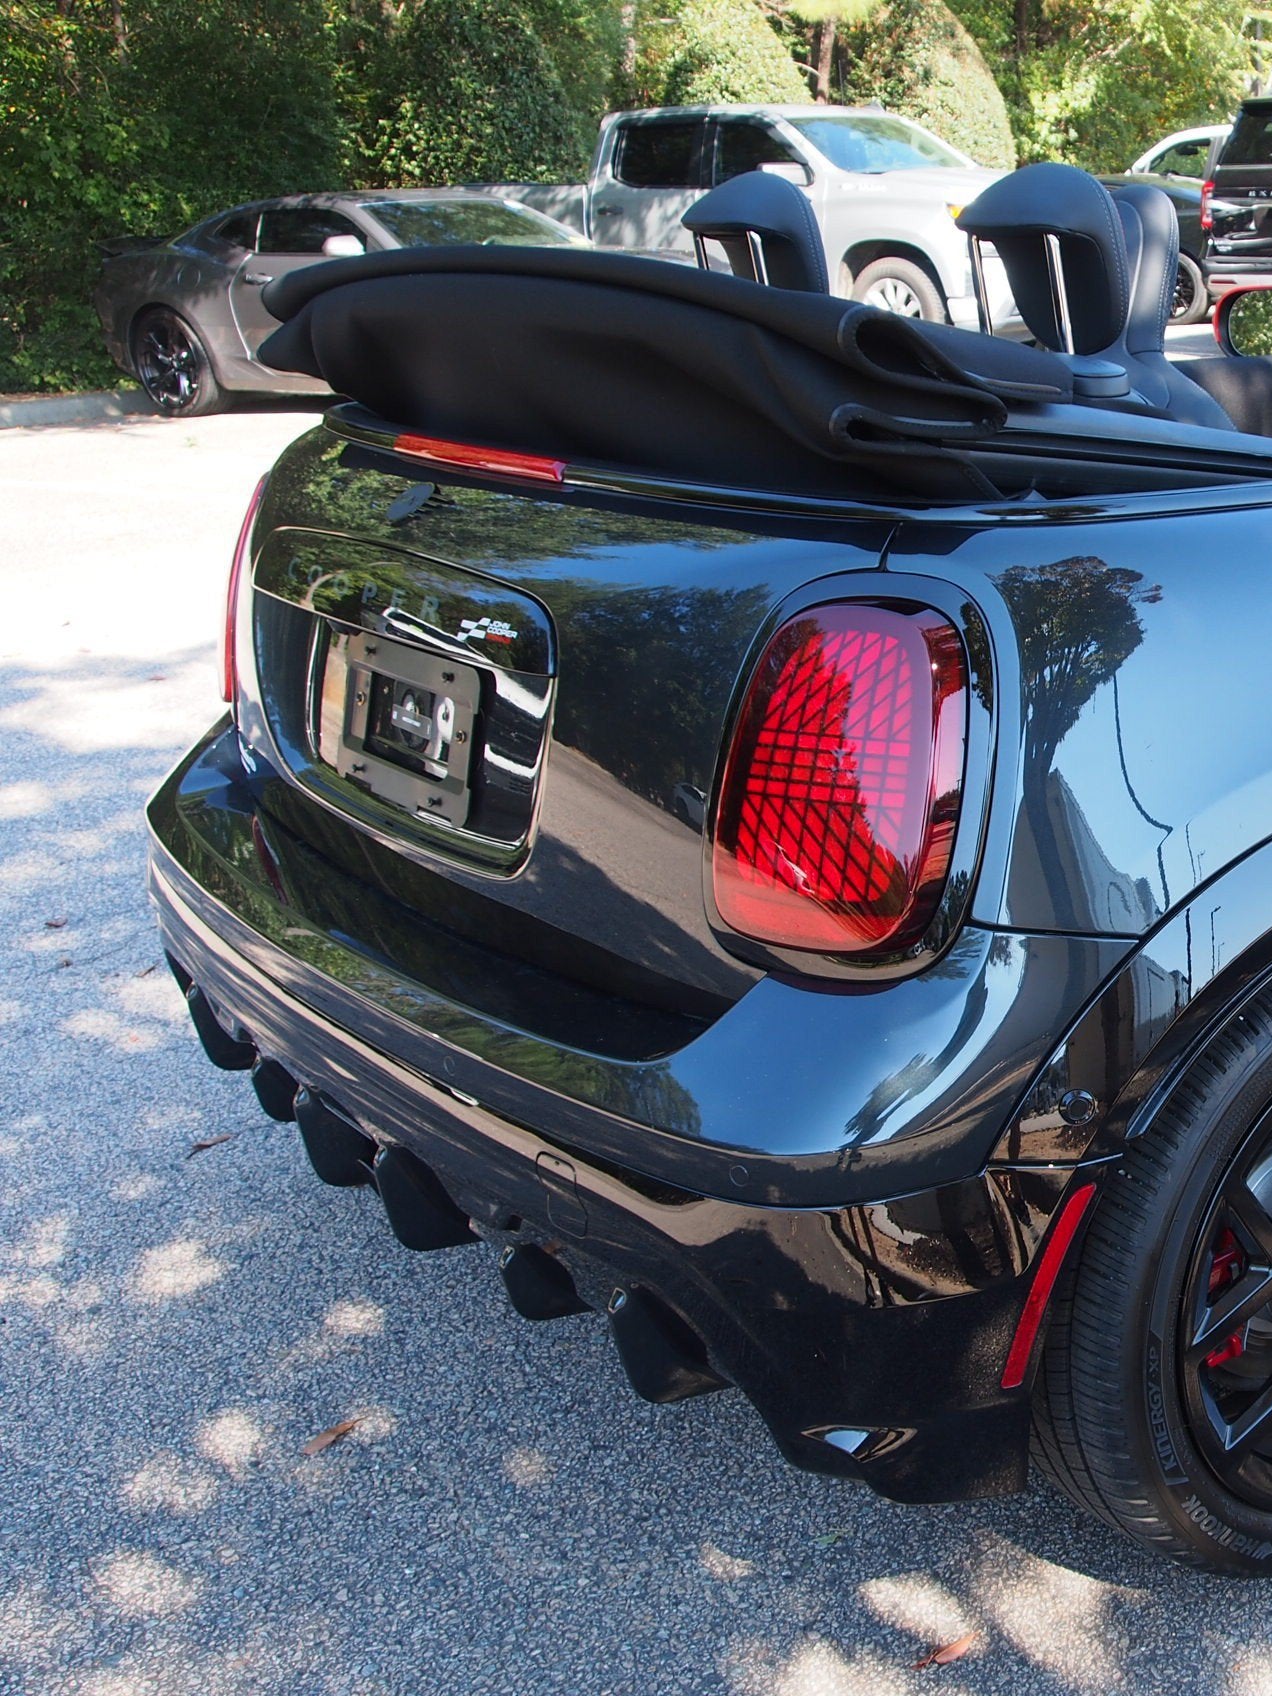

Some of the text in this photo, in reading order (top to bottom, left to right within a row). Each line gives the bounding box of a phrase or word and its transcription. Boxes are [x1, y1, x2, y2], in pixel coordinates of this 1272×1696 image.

[288, 557, 440, 623] COOPER
[486, 626, 518, 640] COOPER
[1148, 1381, 1177, 1471] KINERGY
